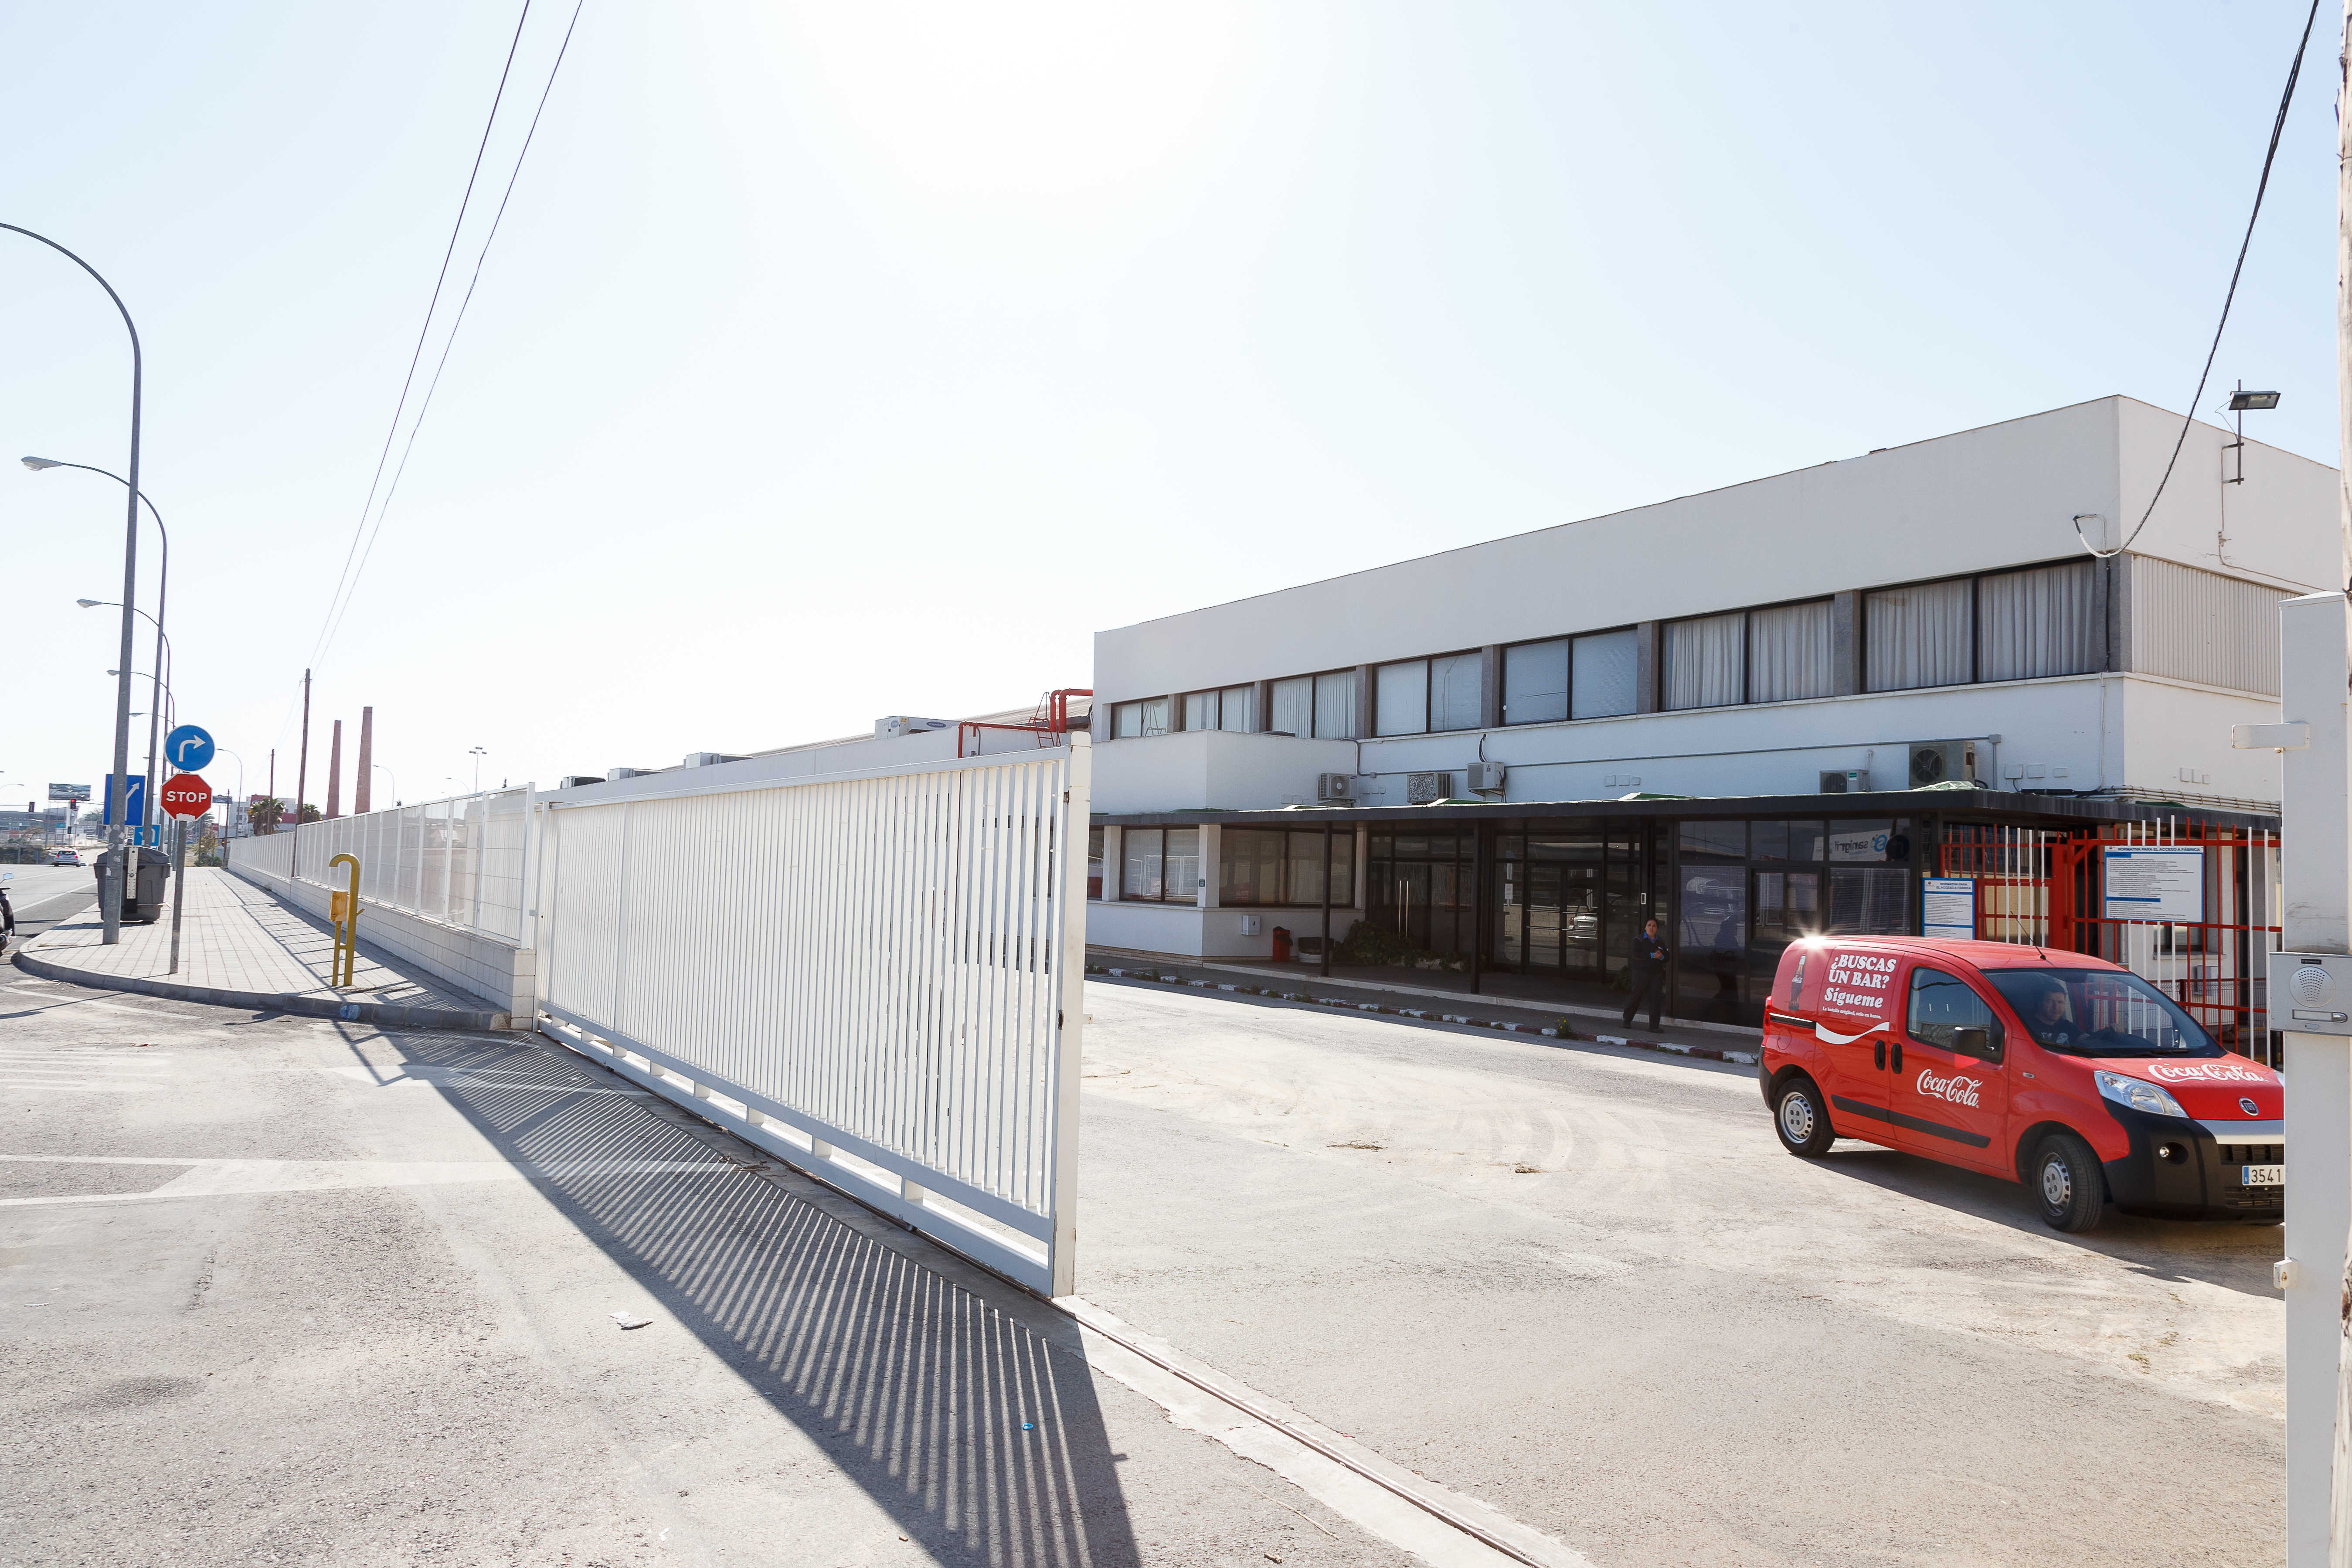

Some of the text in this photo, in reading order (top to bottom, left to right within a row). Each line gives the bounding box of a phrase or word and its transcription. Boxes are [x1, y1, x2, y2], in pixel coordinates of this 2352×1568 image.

[166, 791, 207, 803] STOP
[1831, 954, 1897, 972] ¿BUSCAS
[1829, 969, 1890, 989] UN BAR?
[1824, 987, 1883, 1008] Sígueme
[2148, 1063, 2266, 1082] Coca-Cola
[1917, 1069, 1983, 1107] Coca-Cola
[2251, 1169, 2281, 1183] 3541
